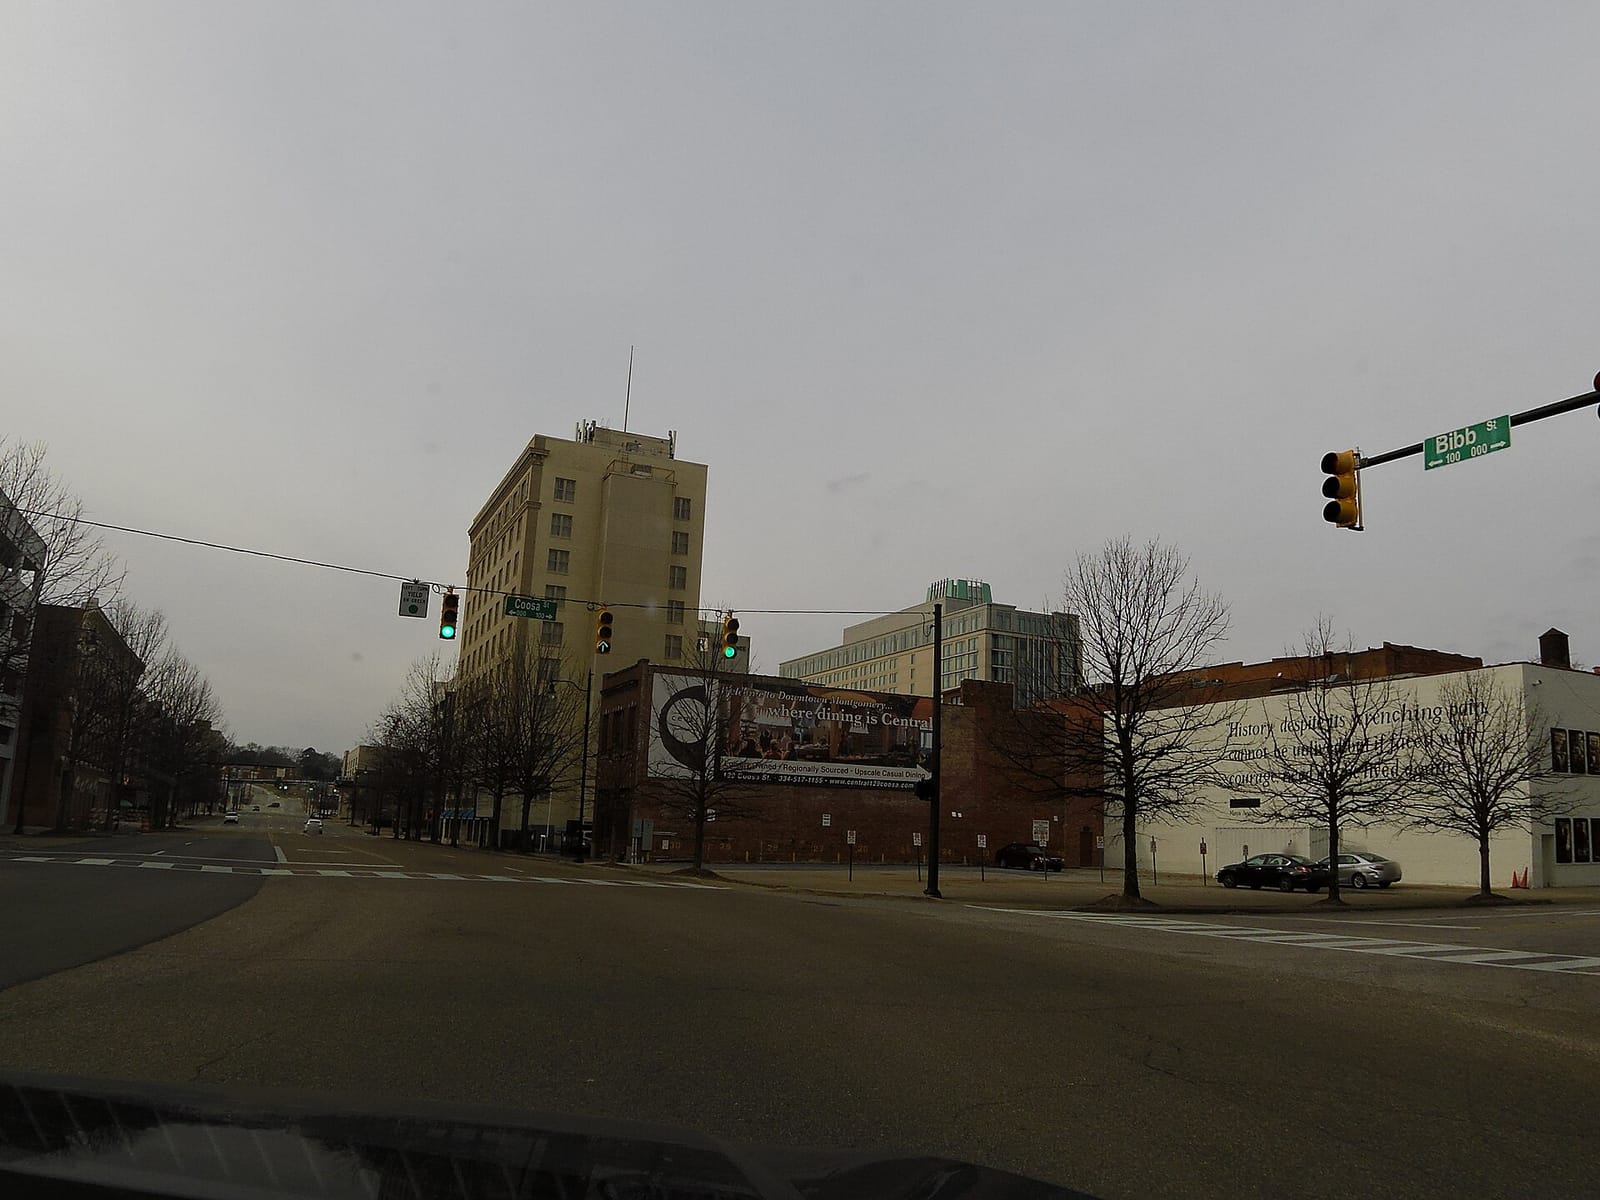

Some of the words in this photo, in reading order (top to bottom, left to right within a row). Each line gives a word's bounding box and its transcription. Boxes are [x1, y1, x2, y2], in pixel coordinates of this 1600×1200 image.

[1435, 428, 1477, 455] Bibb
[1486, 420, 1497, 431] St
[1446, 451, 1461, 464] 100
[1470, 443, 1488, 457] 000
[514, 598, 541, 611] Coosa
[778, 690, 827, 704] Downtown
[768, 704, 813, 720] where
[817, 707, 862, 728] dining
[866, 711, 878, 725] is
[881, 712, 933, 729] Central
[737, 772, 760, 780] Coosa
[782, 763, 818, 775] Regionally
[820, 766, 849, 774] Sourced
[854, 768, 881, 778] Upscale
[881, 770, 905, 778] Casual
[905, 772, 926, 780] Dining
